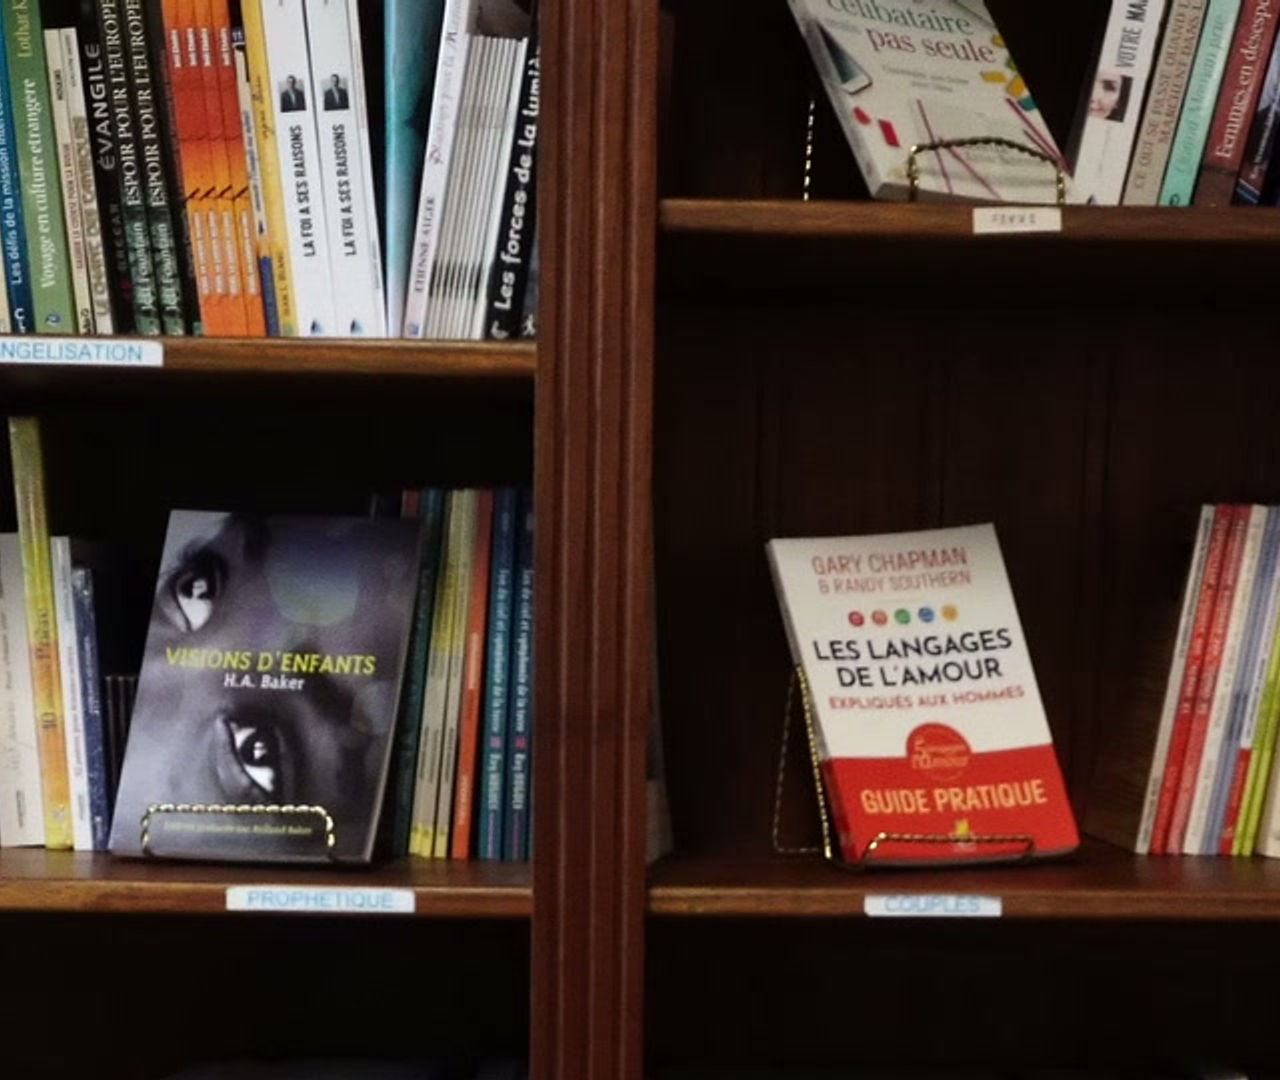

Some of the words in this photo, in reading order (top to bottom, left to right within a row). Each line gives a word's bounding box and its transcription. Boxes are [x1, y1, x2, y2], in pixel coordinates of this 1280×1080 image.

[866, 28, 916, 54] pas
[921, 38, 997, 63] seule
[1115, 25, 1142, 68] VOTRE
[84, 42, 116, 171] ÉVANGILE
[112, 87, 133, 139] POUR
[1214, 88, 1253, 158] Femmes
[1235, 64, 1254, 86] en
[519, 123, 538, 148] la
[289, 124, 306, 178] RAISONS
[27, 155, 49, 211] culture
[119, 142, 142, 207] ESPOIR
[511, 154, 531, 184] de
[2, 197, 15, 210] la
[296, 180, 310, 204] SES
[3, 211, 16, 228] de
[37, 213, 49, 232] en
[298, 205, 311, 215] A
[300, 217, 313, 237] FOI
[499, 190, 528, 264] forces
[4, 230, 21, 259] défis
[302, 240, 316, 257] LA
[10, 263, 24, 285] Les
[37, 235, 58, 288] Voyage
[493, 271, 515, 311] Les
[810, 553, 862, 576] GARY
[867, 546, 968, 574] CHAPMAN
[890, 569, 972, 591] SOUTHERN
[812, 638, 862, 662] LES
[866, 627, 1012, 660] LANGAGES
[166, 646, 251, 672] VISIONS
[256, 650, 377, 675] D'ENFANTS
[836, 666, 874, 689] DE
[878, 657, 1003, 687] L'AMOUR
[222, 674, 255, 689] H.A.
[261, 674, 306, 691] Baker
[918, 691, 948, 707] AUX
[953, 684, 1026, 704] HOMMES
[860, 787, 932, 815] GUIDE
[933, 777, 1049, 812] PRATIQUE
[247, 890, 393, 909] PROPHETIQUE
[883, 894, 982, 914] COUPLES
